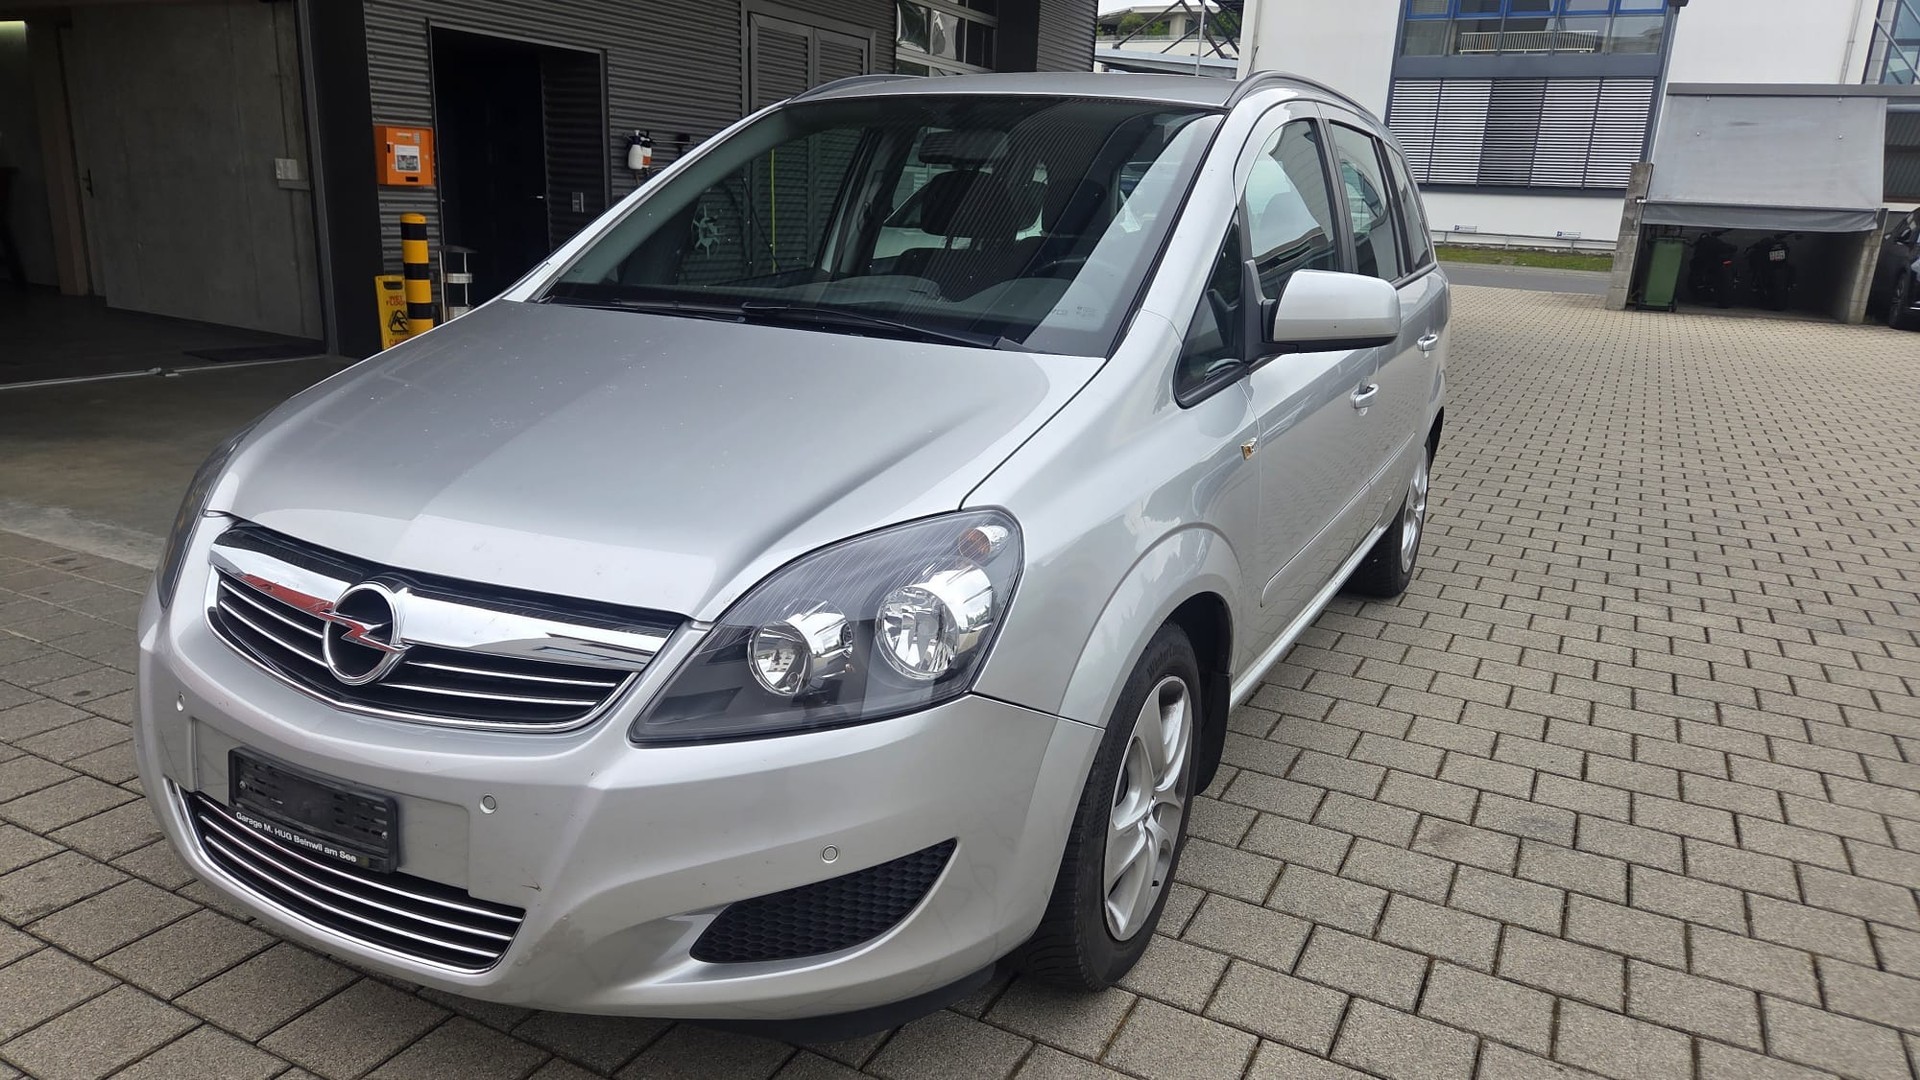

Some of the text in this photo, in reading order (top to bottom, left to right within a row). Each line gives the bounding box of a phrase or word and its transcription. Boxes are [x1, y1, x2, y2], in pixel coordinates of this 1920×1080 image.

[236, 811, 357, 863] Garage M. HUG Beinwil am See
